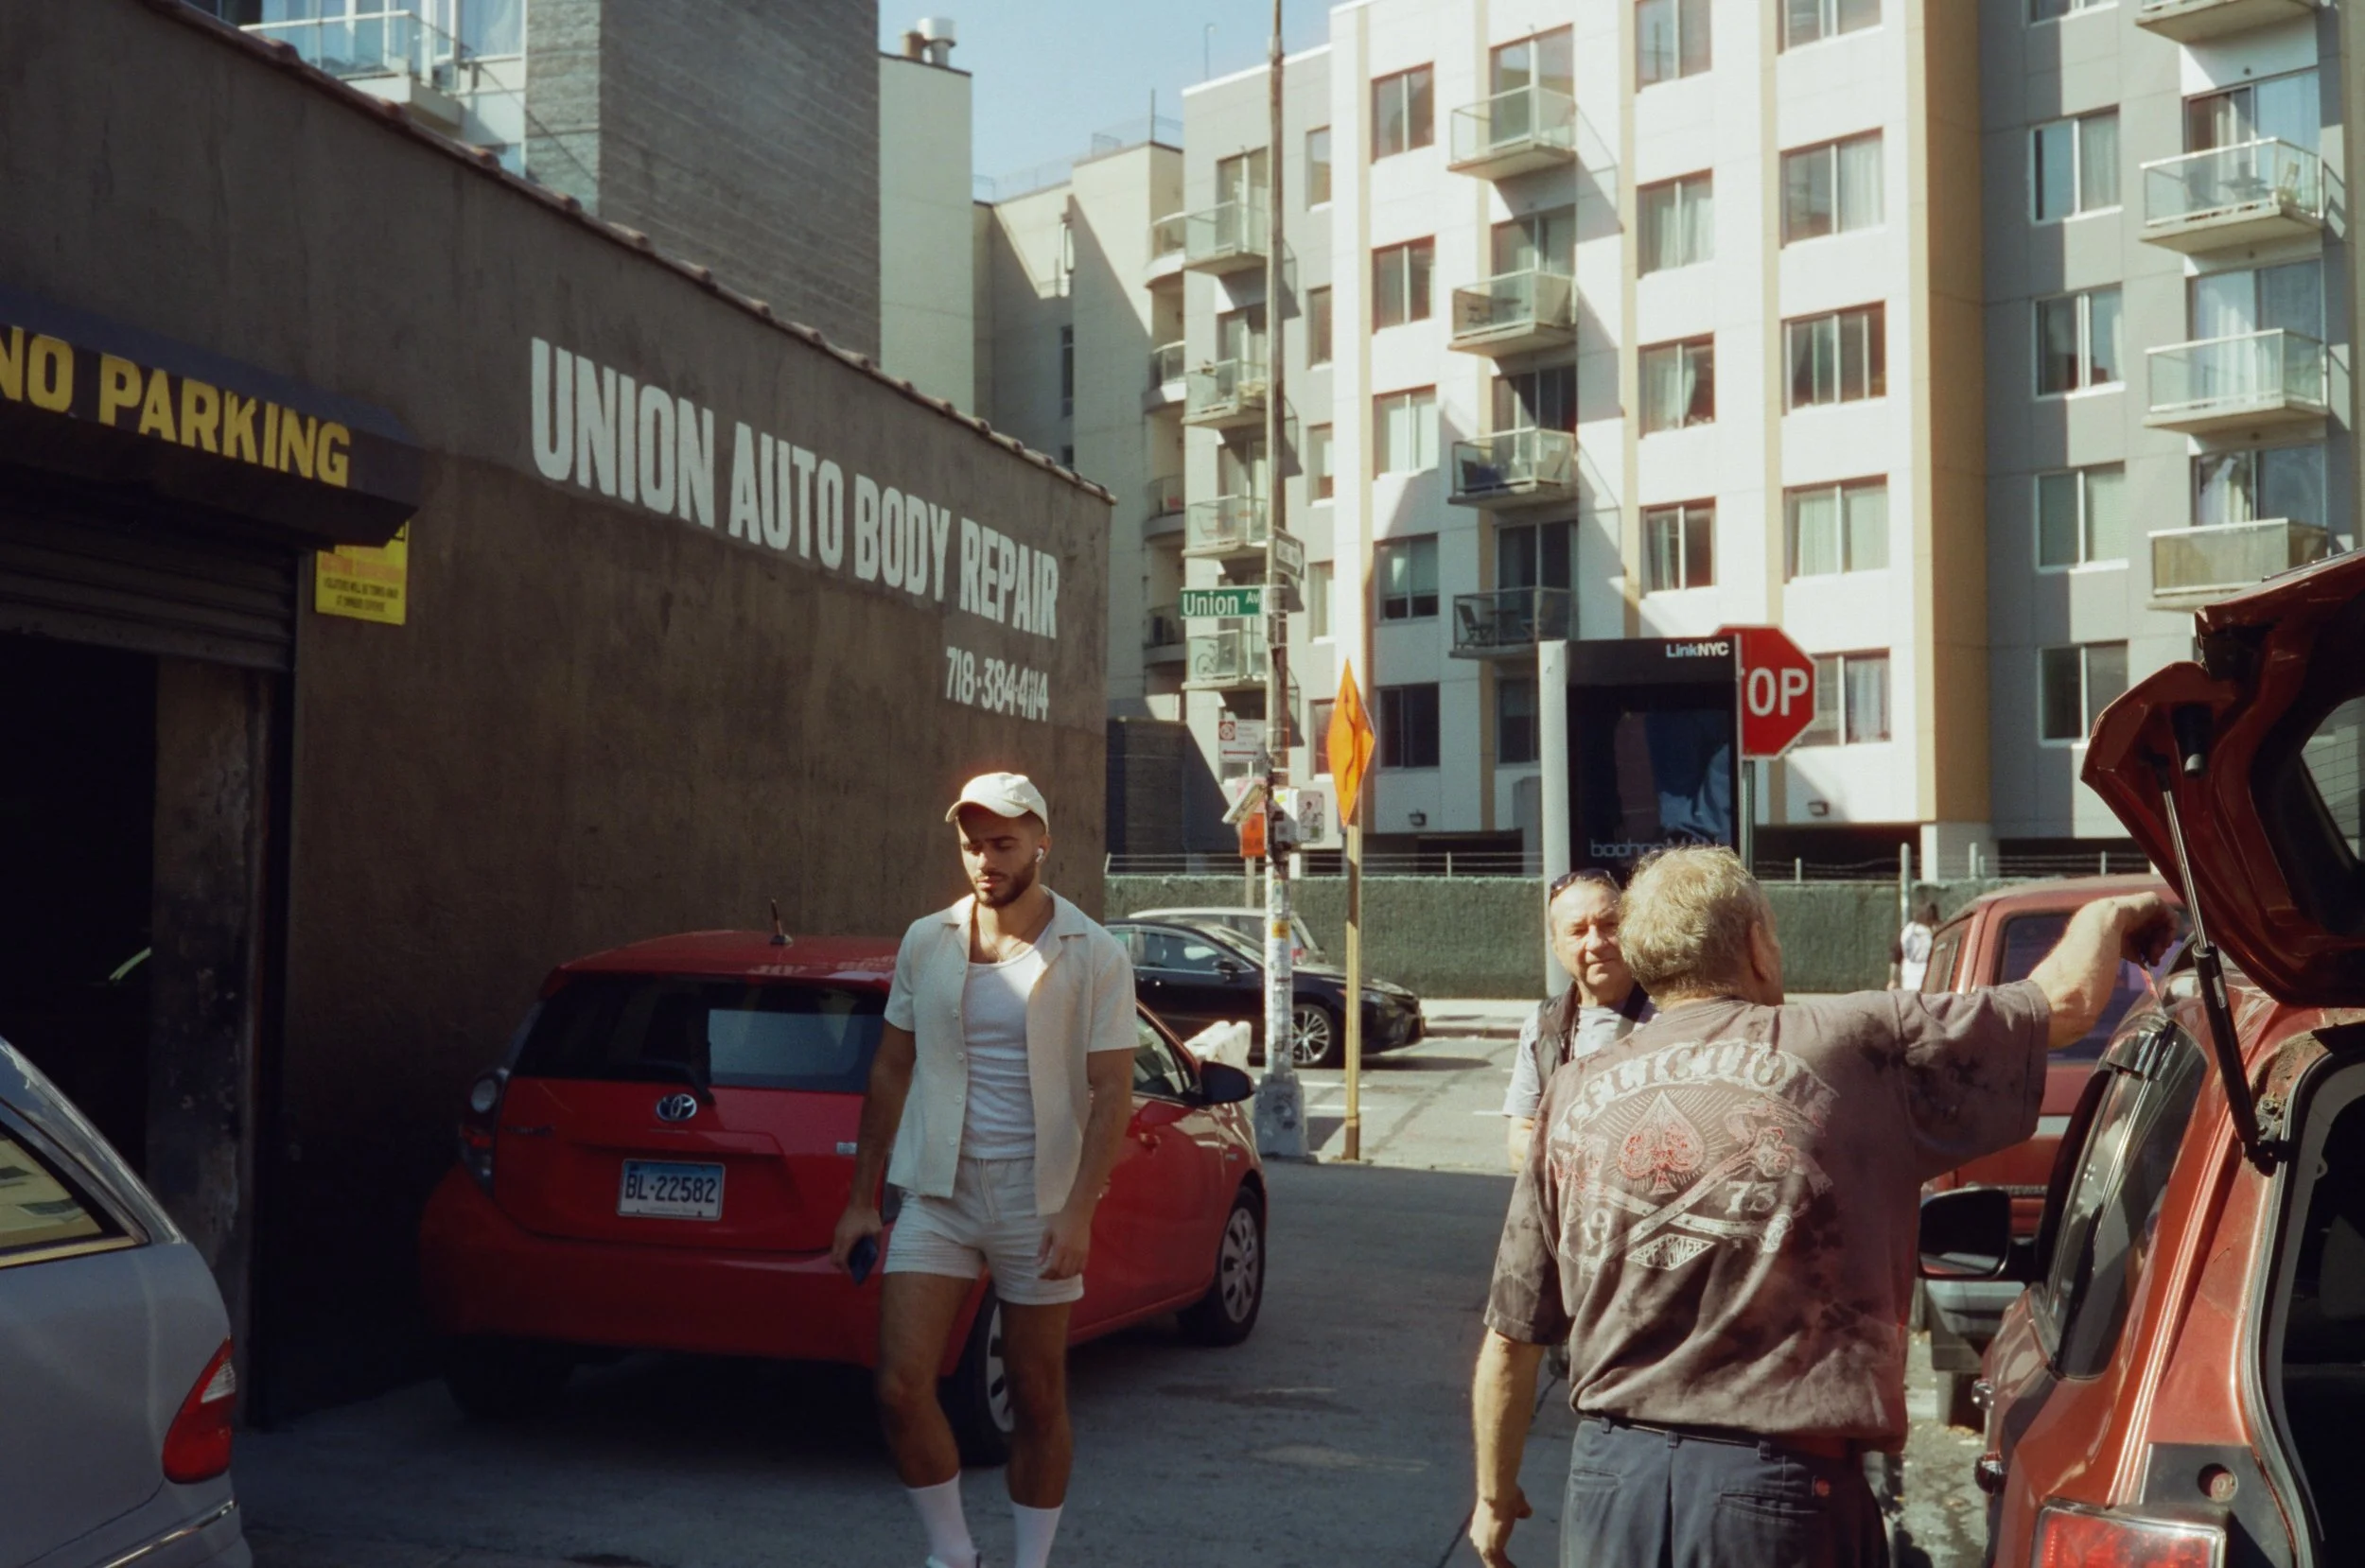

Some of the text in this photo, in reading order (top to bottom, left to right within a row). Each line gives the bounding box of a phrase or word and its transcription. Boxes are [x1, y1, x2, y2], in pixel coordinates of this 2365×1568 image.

[0, 325, 351, 488] NO PARKING
[531, 337, 1059, 639] UNION AUTO BODY REPAIR
[1183, 591, 1239, 616] Union
[1666, 641, 1729, 658] LinkNYC
[1741, 667, 1809, 717] OP
